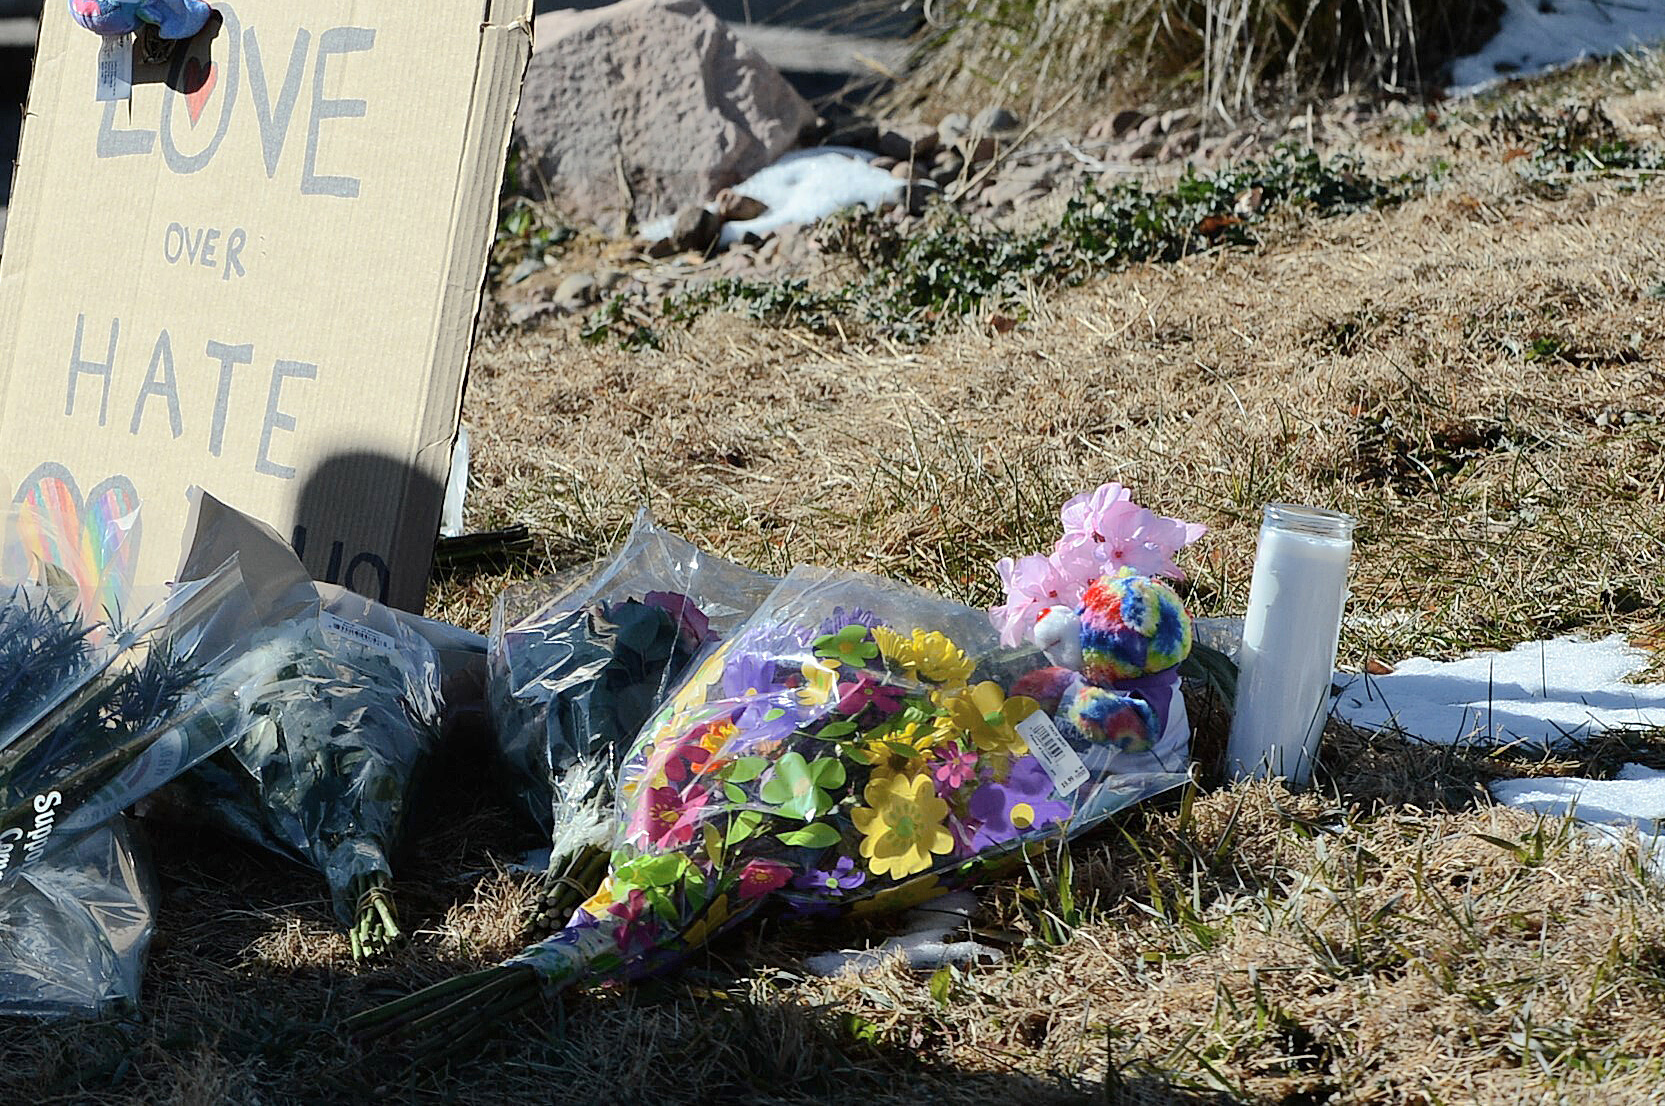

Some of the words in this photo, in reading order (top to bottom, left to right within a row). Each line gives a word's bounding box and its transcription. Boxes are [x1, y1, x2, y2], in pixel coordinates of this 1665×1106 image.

[95, 2, 377, 199] LOVE
[163, 222, 247, 280] OVER
[64, 313, 319, 479] HATE
